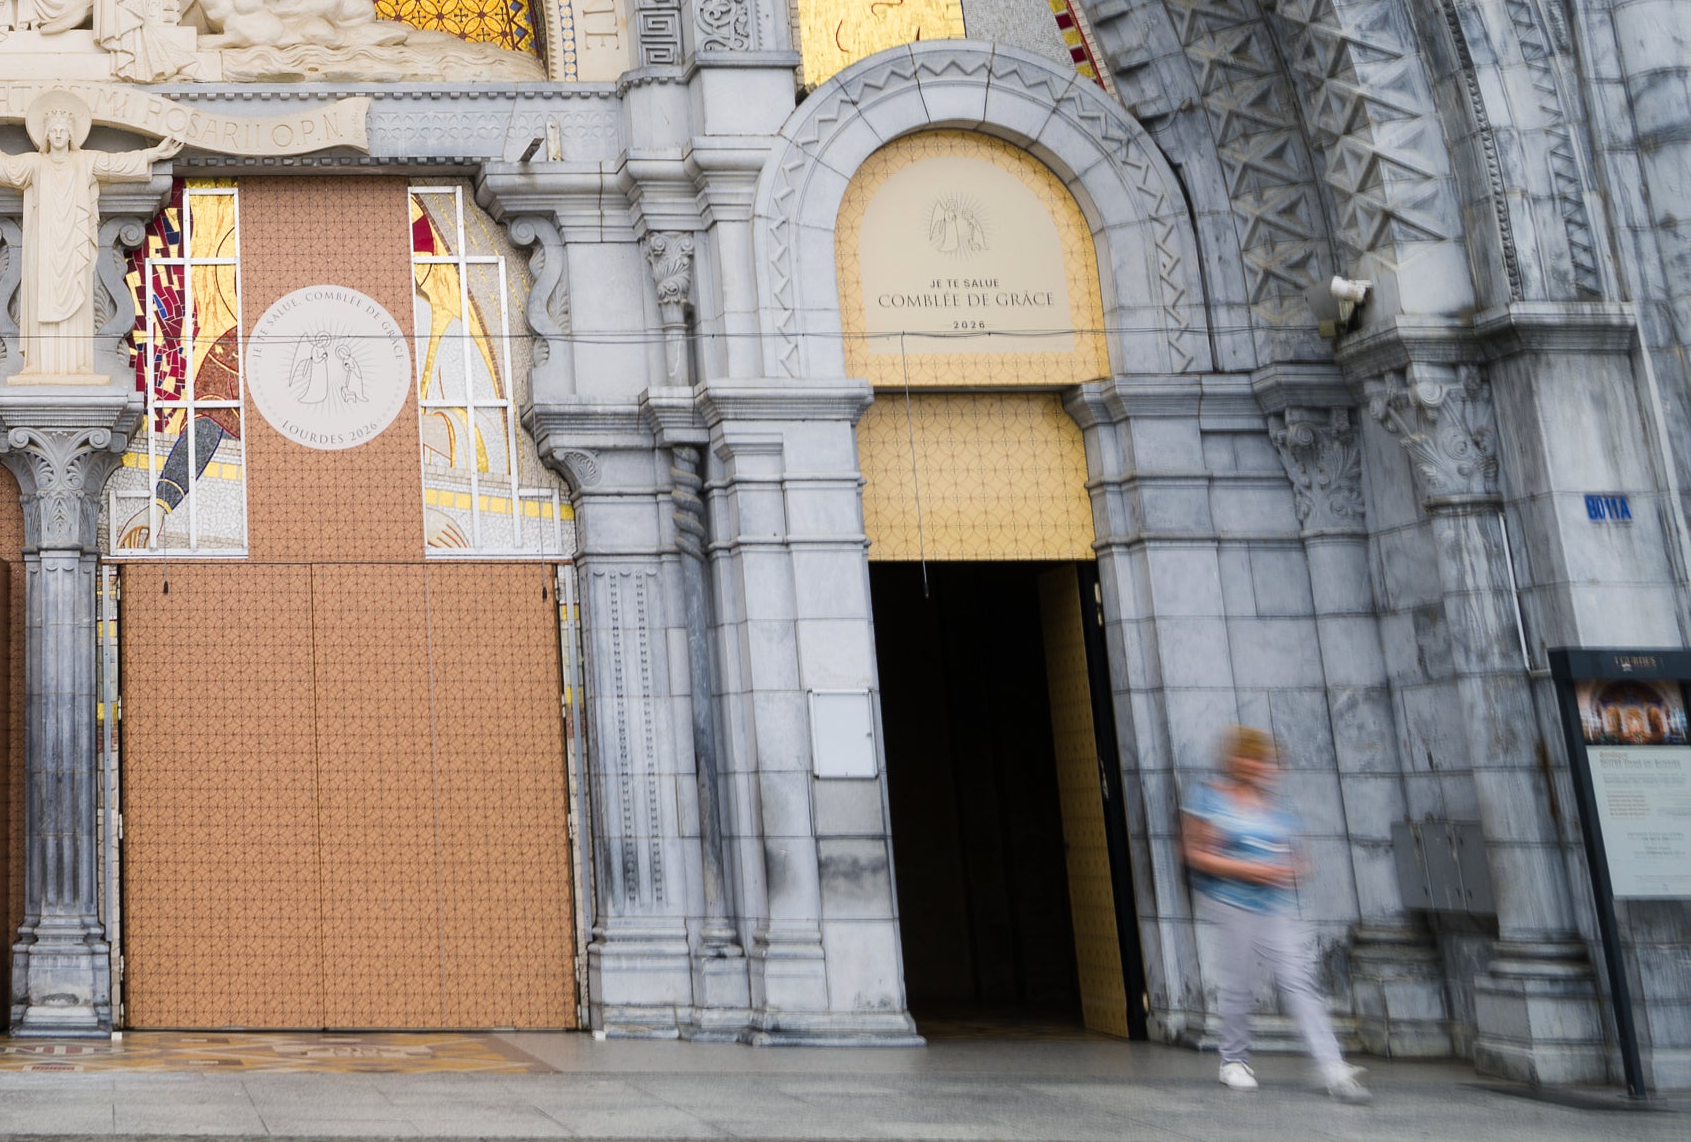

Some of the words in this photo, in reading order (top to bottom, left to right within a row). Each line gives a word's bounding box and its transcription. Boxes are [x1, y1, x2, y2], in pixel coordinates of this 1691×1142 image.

[141, 99, 260, 149] ROSARII
[930, 279, 942, 288] JE
[947, 279, 959, 288] TE
[964, 278, 999, 288] SALUE
[878, 292, 960, 308] COMBLÉE
[968, 293, 990, 307] DE
[996, 291, 1054, 307] GRÂCE
[365, 305, 381, 320] DE
[953, 321, 986, 330] 2026
[282, 420, 345, 444] LOURDES
[349, 421, 378, 441] 2026
